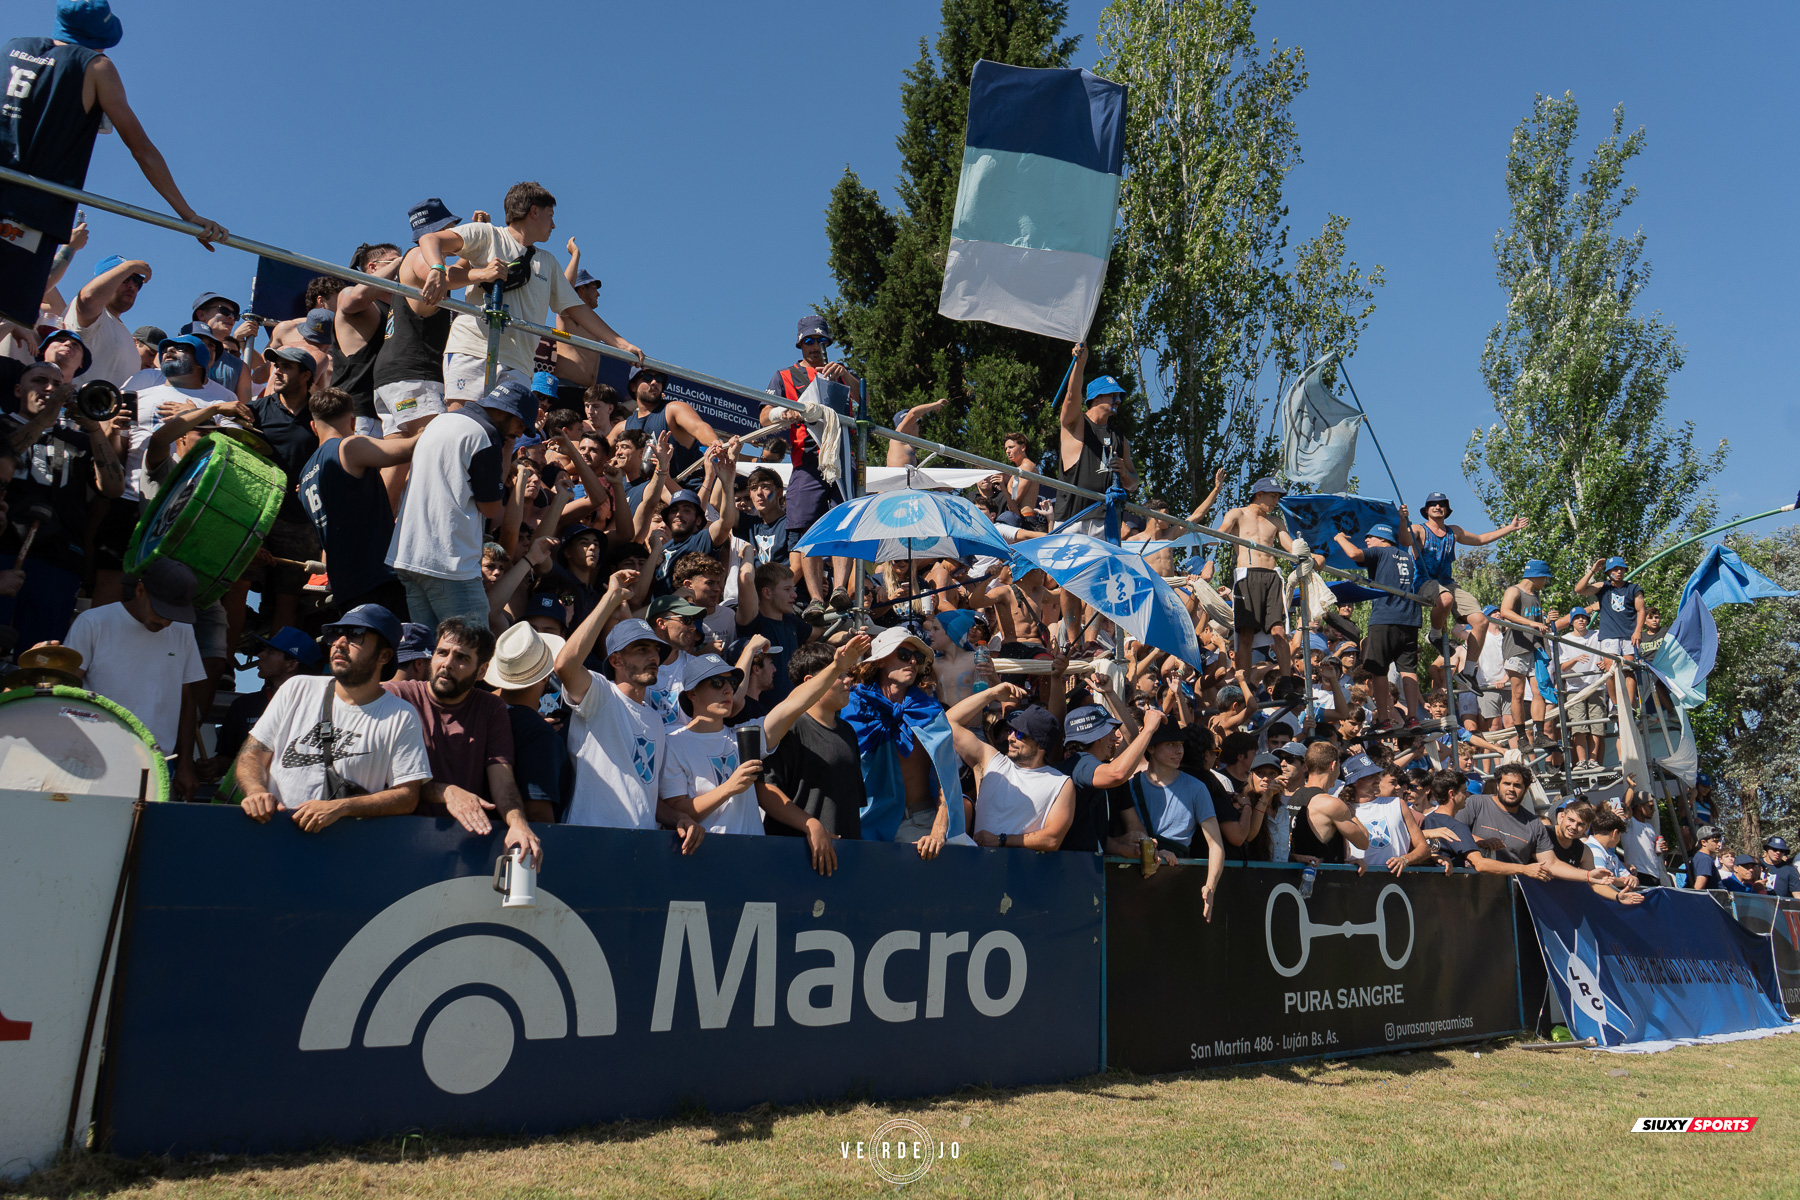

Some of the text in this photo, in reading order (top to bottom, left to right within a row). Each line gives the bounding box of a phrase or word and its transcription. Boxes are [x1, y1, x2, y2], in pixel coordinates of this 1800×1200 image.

[666, 382, 712, 402] AISLACIÓN
[713, 396, 748, 415] TÉRMICA
[300, 722, 362, 753] NKE
[650, 900, 1028, 1032] Macro
[1284, 984, 1404, 1014] PURA SANGRE
[1569, 966, 1604, 1011] LRC
[1396, 1014, 1474, 1039] purasangrecamisas
[1190, 1043, 1211, 1060] San
[1214, 1037, 1250, 1057] Martín
[1254, 1036, 1274, 1052] 486
[1282, 1032, 1309, 1053] Luján
[1311, 1031, 1325, 1047] Bs.
[1326, 1029, 1339, 1044] As.
